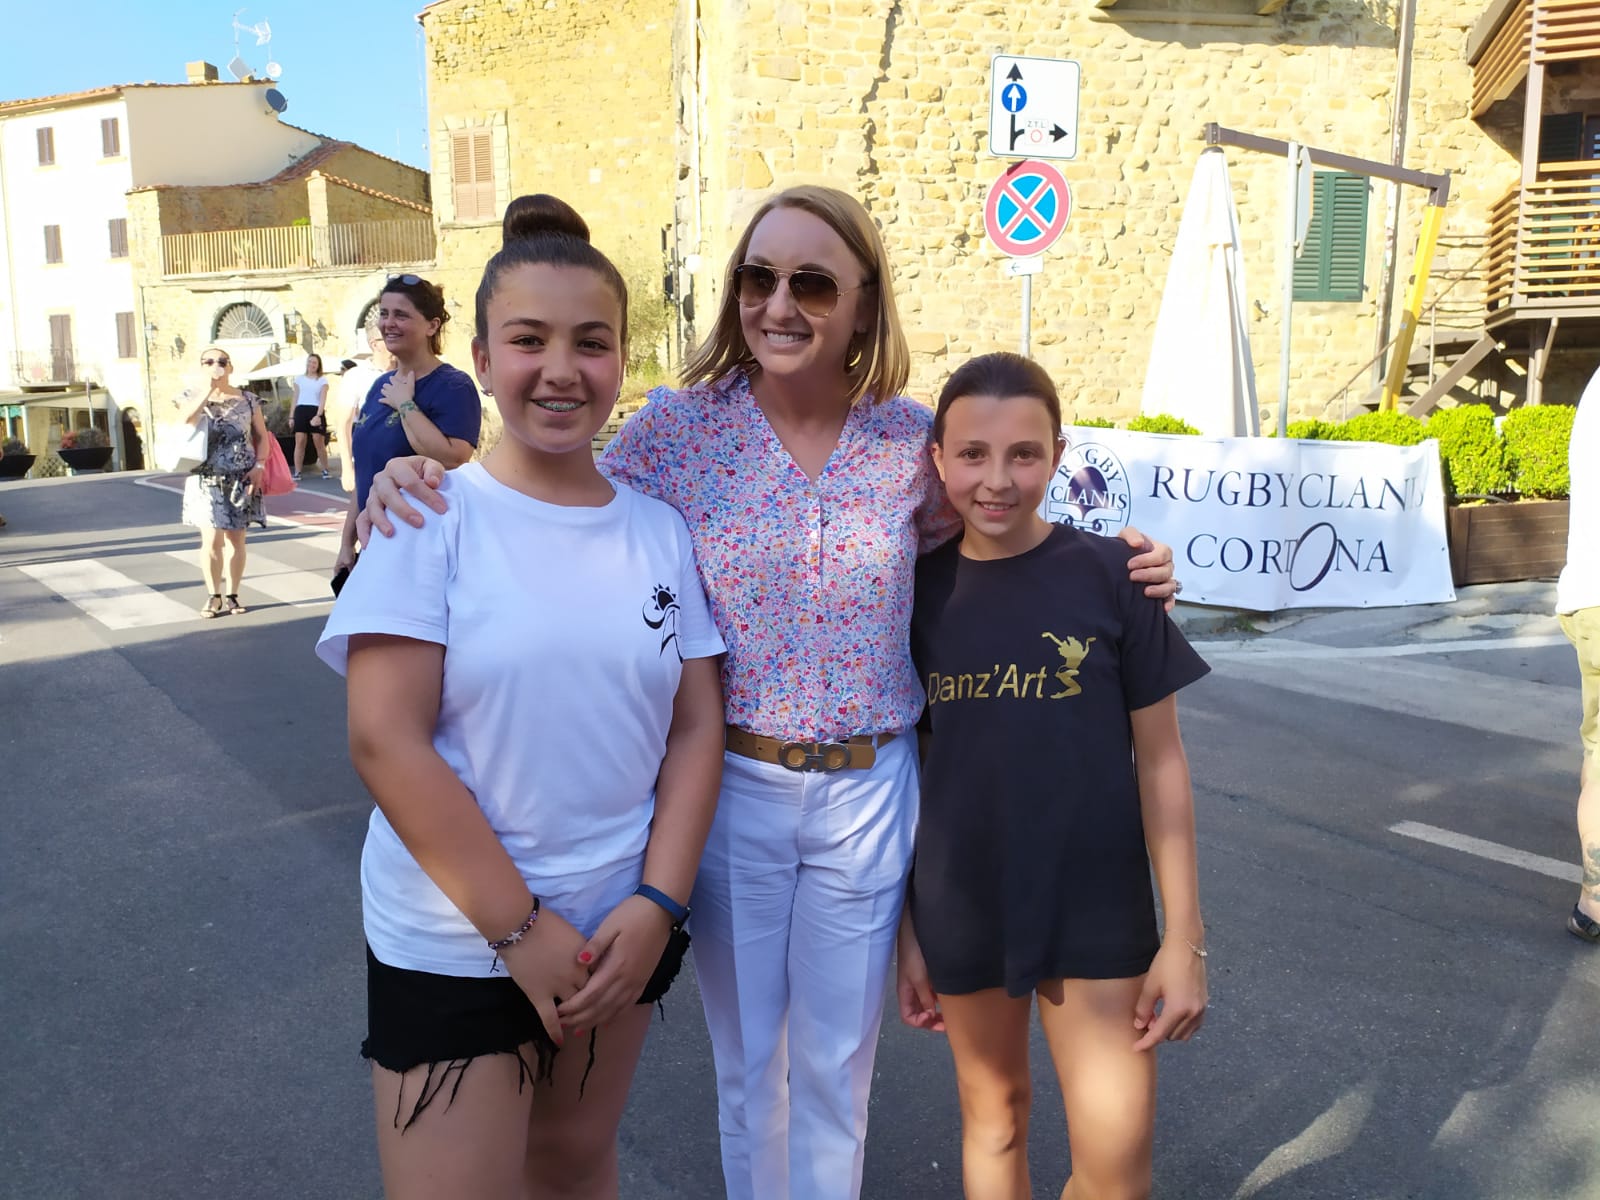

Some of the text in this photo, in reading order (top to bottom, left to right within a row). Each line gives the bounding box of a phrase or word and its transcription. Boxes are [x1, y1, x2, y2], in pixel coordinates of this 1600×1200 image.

[1050, 485, 1127, 510] CLANIS
[1186, 522, 1393, 592] CORTONA
[928, 664, 1047, 705] Danz'Art
